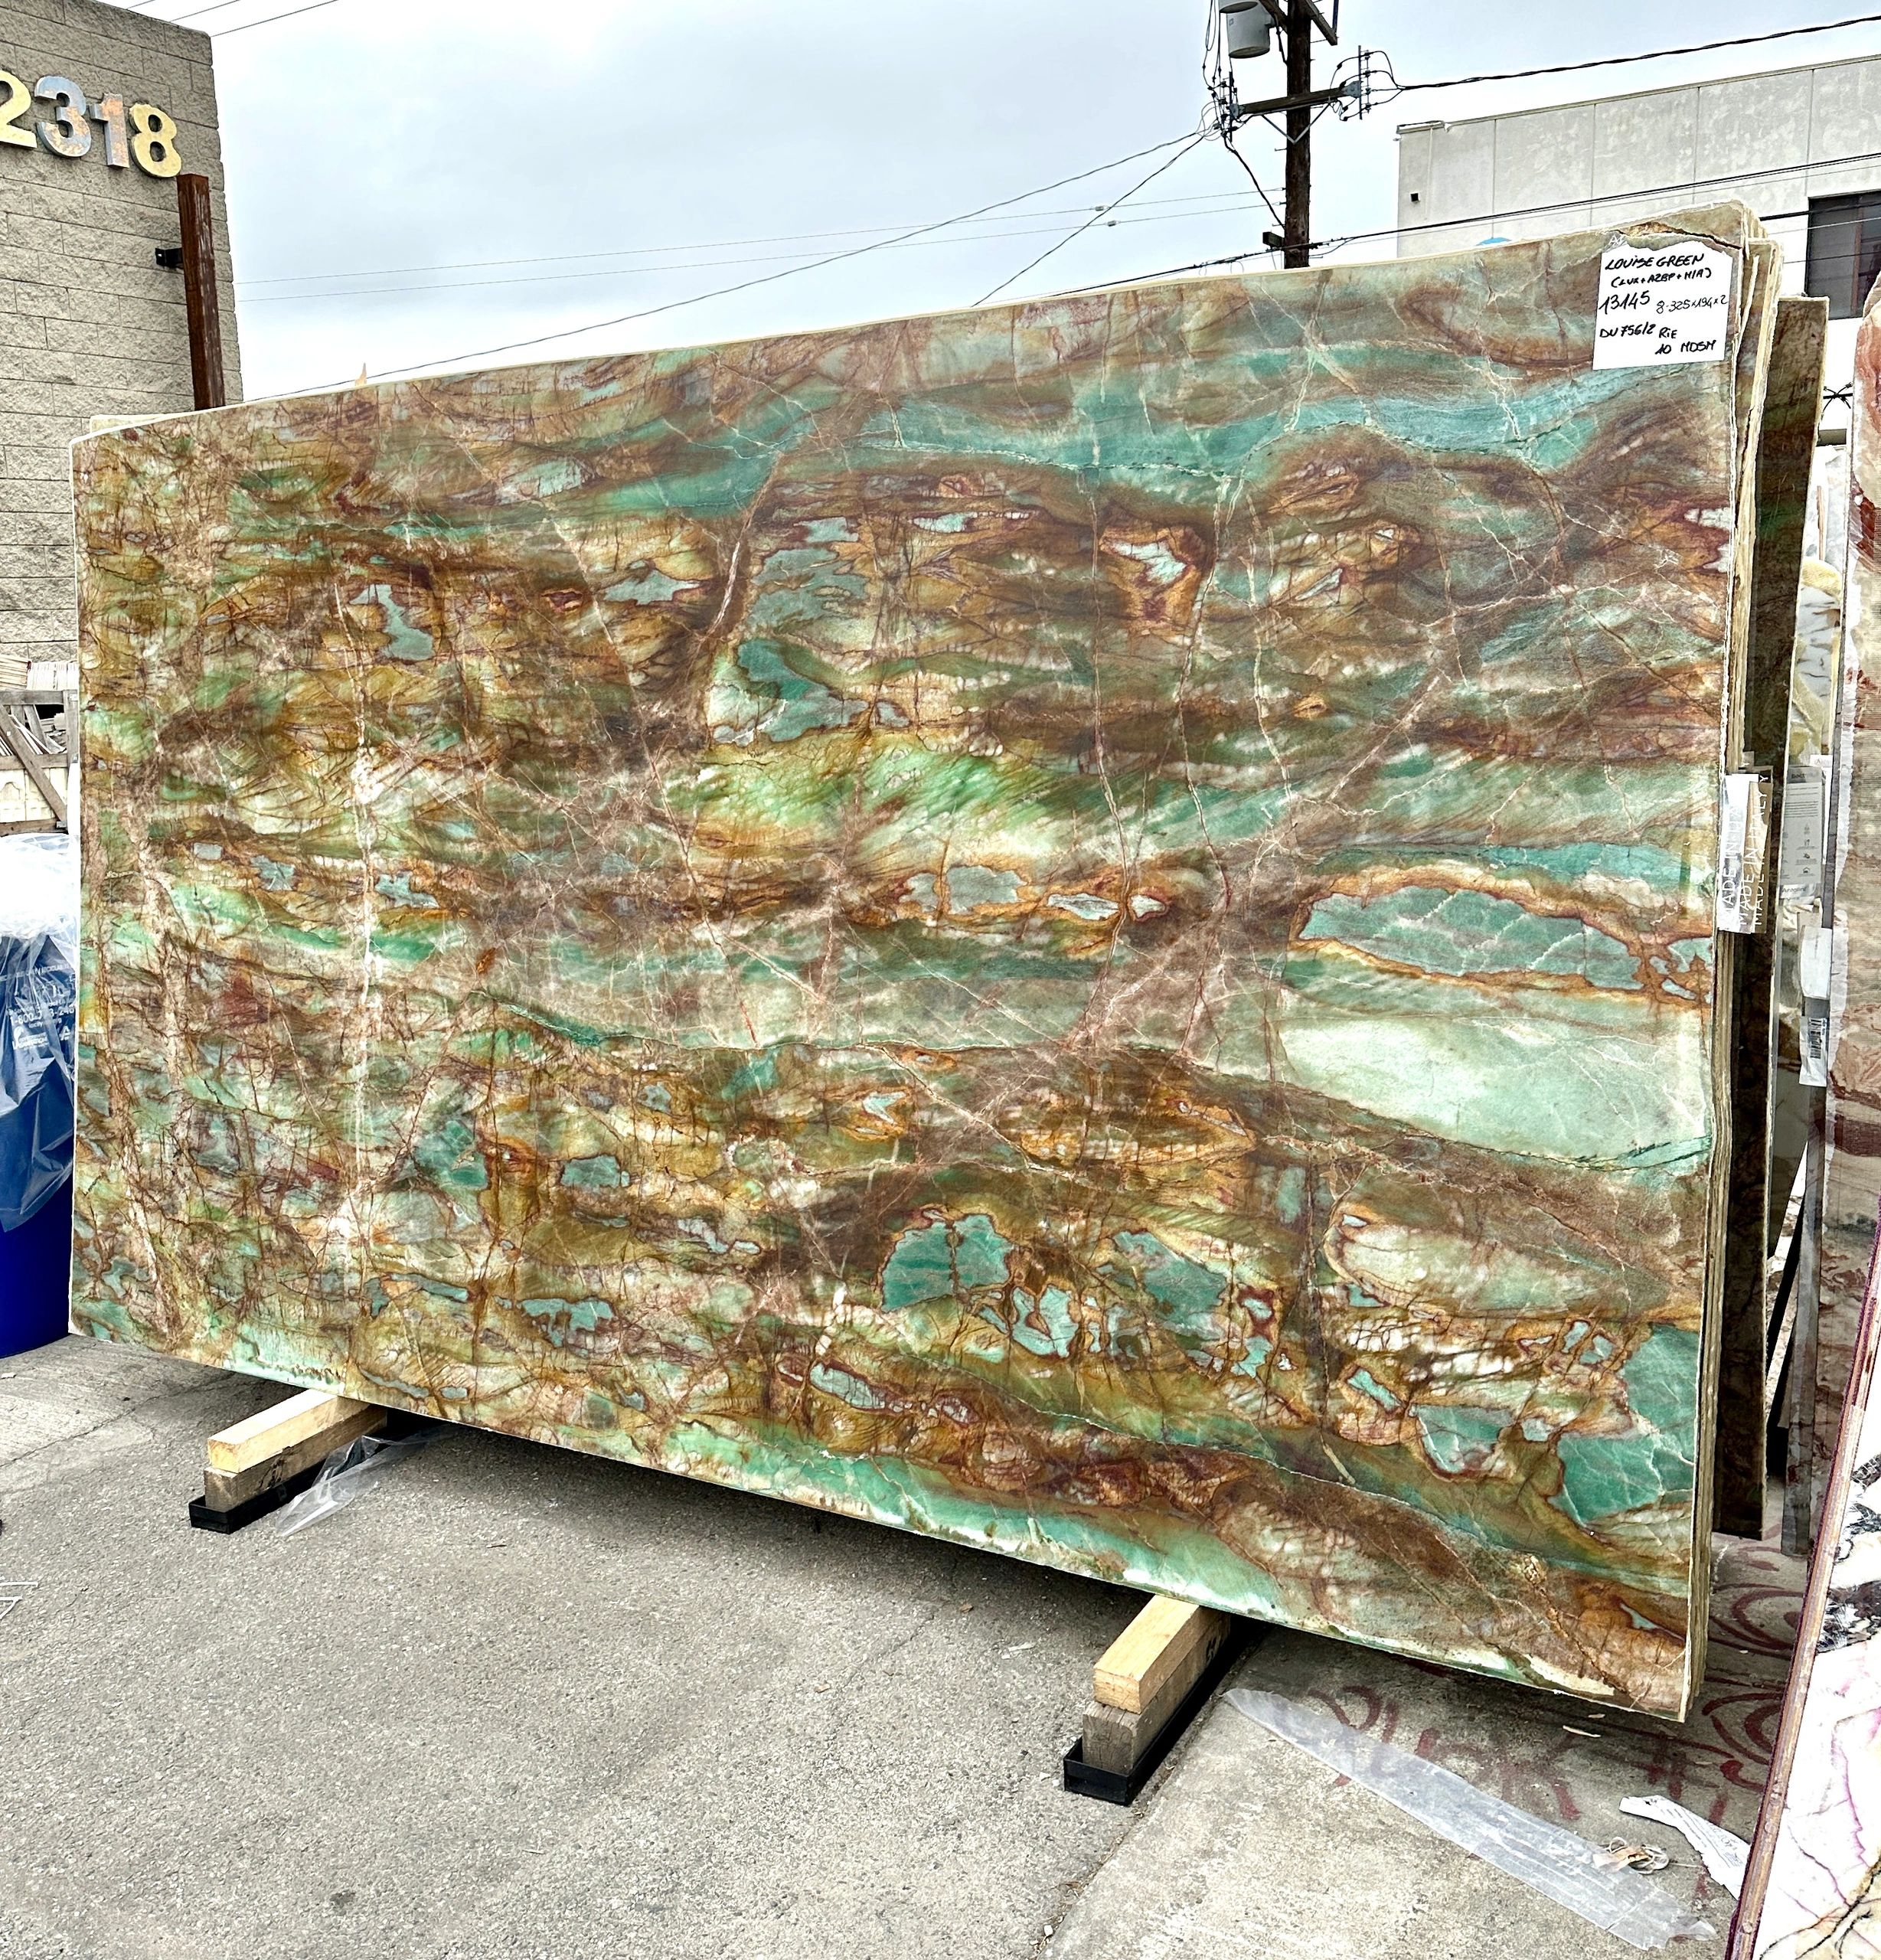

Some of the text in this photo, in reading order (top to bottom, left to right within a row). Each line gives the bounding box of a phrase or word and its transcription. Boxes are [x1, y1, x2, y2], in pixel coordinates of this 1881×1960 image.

[0, 70, 181, 178] 2318
[1656, 253, 1704, 267] GREEN
[1599, 290, 1651, 315] 13145
[1749, 791, 1768, 838] ITALY
[1744, 848, 1759, 865] IN
[1739, 874, 1755, 926] MADE
